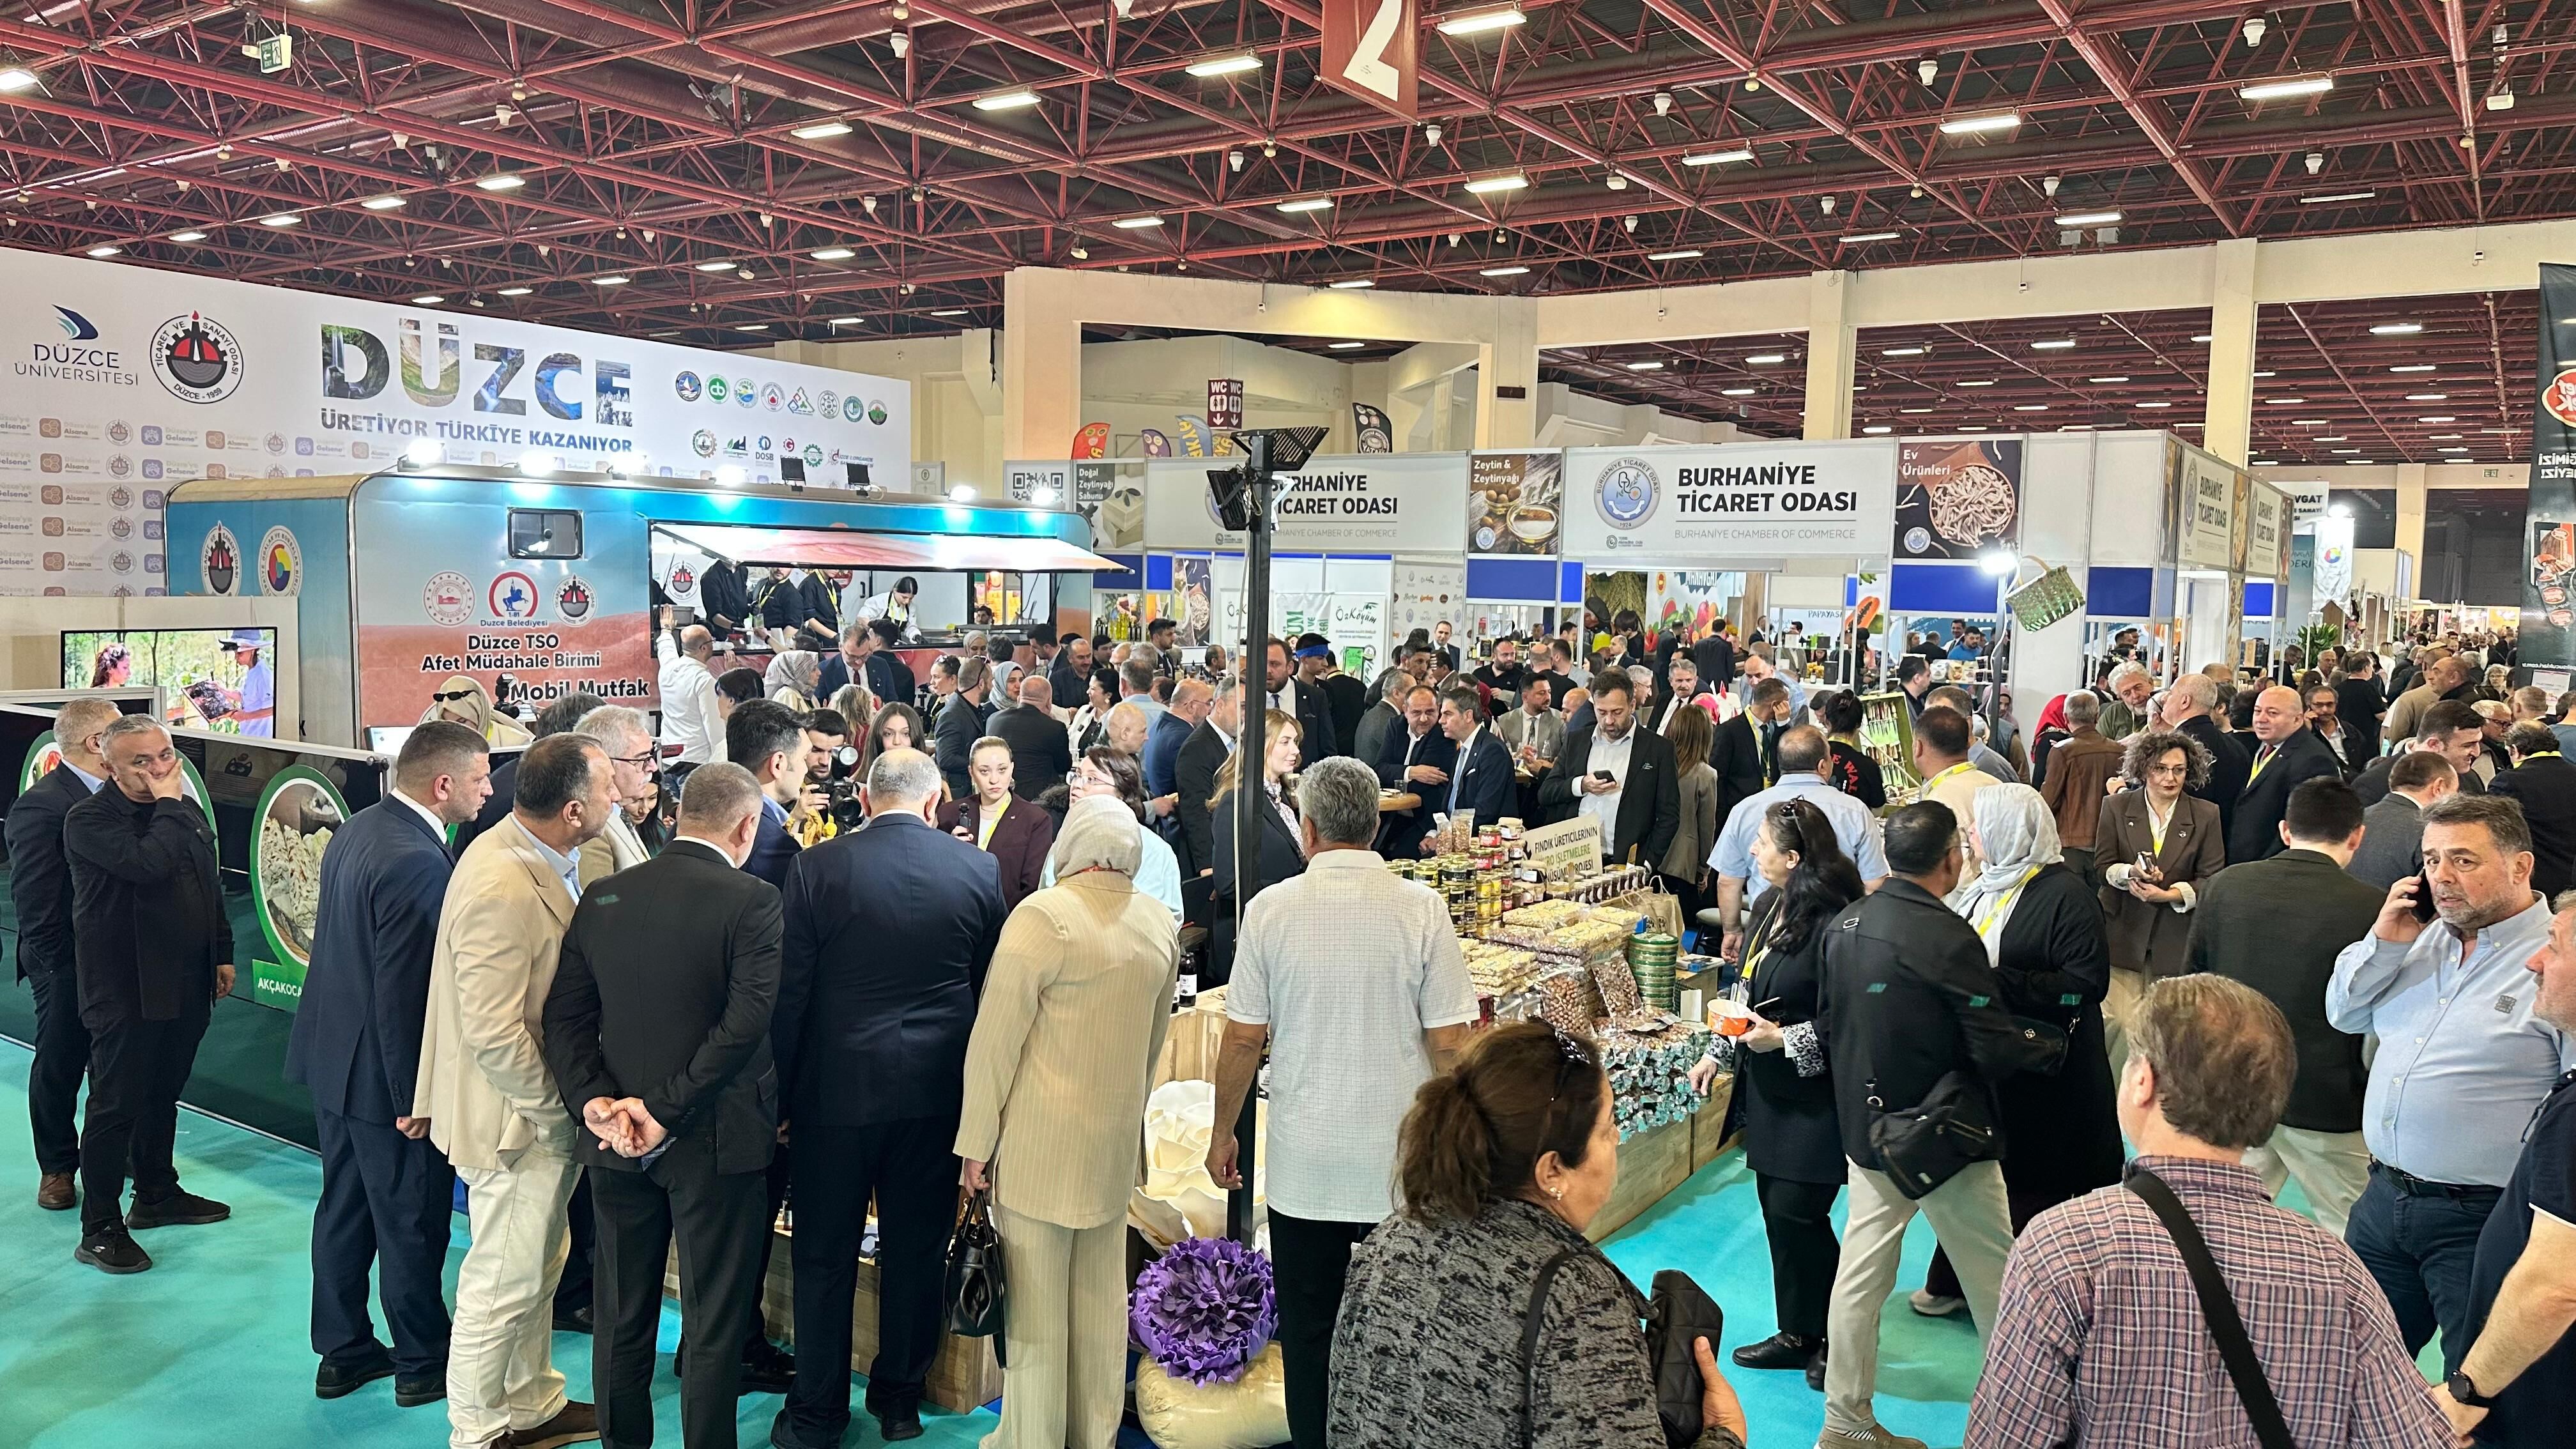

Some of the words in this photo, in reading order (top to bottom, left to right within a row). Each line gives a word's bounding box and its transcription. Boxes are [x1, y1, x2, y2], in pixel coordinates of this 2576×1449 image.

[33, 343, 120, 368] DÜZCE
[155, 330, 169, 367] TİCARET
[172, 321, 186, 330] VE
[203, 322, 234, 346] SANAYİ
[229, 348, 239, 375] ODASI
[15, 362, 138, 385] ÜNİVERSİTESİ
[321, 318, 632, 427] DÜZCE
[174, 383, 200, 399] DÜZCE
[206, 388, 222, 399] 1959
[1211, 382, 1227, 393] WC
[1230, 383, 1241, 394] WC
[0, 422, 30, 430] elsene
[321, 408, 428, 436] ÜRETİYOR
[436, 421, 521, 444] TÜRKİYE
[530, 431, 632, 452] KAZANIYOR
[756, 452, 774, 461] DOSB
[1903, 449, 1919, 460] Ev
[1079, 468, 1098, 478] Doğal
[1474, 459, 1502, 471] Zeytin
[1504, 459, 1511, 469] &
[1903, 463, 1951, 475] Ürünleri
[1473, 473, 1519, 484] Zeytinyağı
[1597, 461, 1622, 494] BURHANİYE
[1623, 459, 1650, 471] TİCARET
[1649, 471, 1659, 493] ODASI
[1678, 461, 1816, 486] BURHANİYE
[1078, 480, 1114, 491] Zeytinyağı
[2200, 475, 2223, 502] BURHANİYE
[1342, 498, 1398, 514] ODASI
[1677, 490, 1775, 512] TİCARET
[1781, 492, 1857, 511] ODASI
[2295, 495, 2322, 503] VGAT
[1308, 529, 1342, 537] CHAMBER
[1344, 529, 1353, 537] OF
[1355, 529, 1397, 537] COMMERCE
[1675, 529, 1729, 539] BURHANİYE
[1731, 529, 1779, 539] CHAMBER
[1782, 529, 1795, 538] OF
[1798, 529, 1856, 539] COMMERCE
[468, 635, 520, 650] Düzce
[525, 634, 559, 648] TSO
[422, 656, 460, 671] Afet
[466, 654, 549, 670] Müdahale
[554, 652, 601, 667] Birimi
[511, 681, 569, 702] Mobil
[578, 678, 649, 698] Mutfak
[1535, 838, 1554, 854] FINDIK
[1554, 824, 1598, 847] ÜRETİCİLERİNİN
[257, 977, 302, 997] AKÇAKOCA
